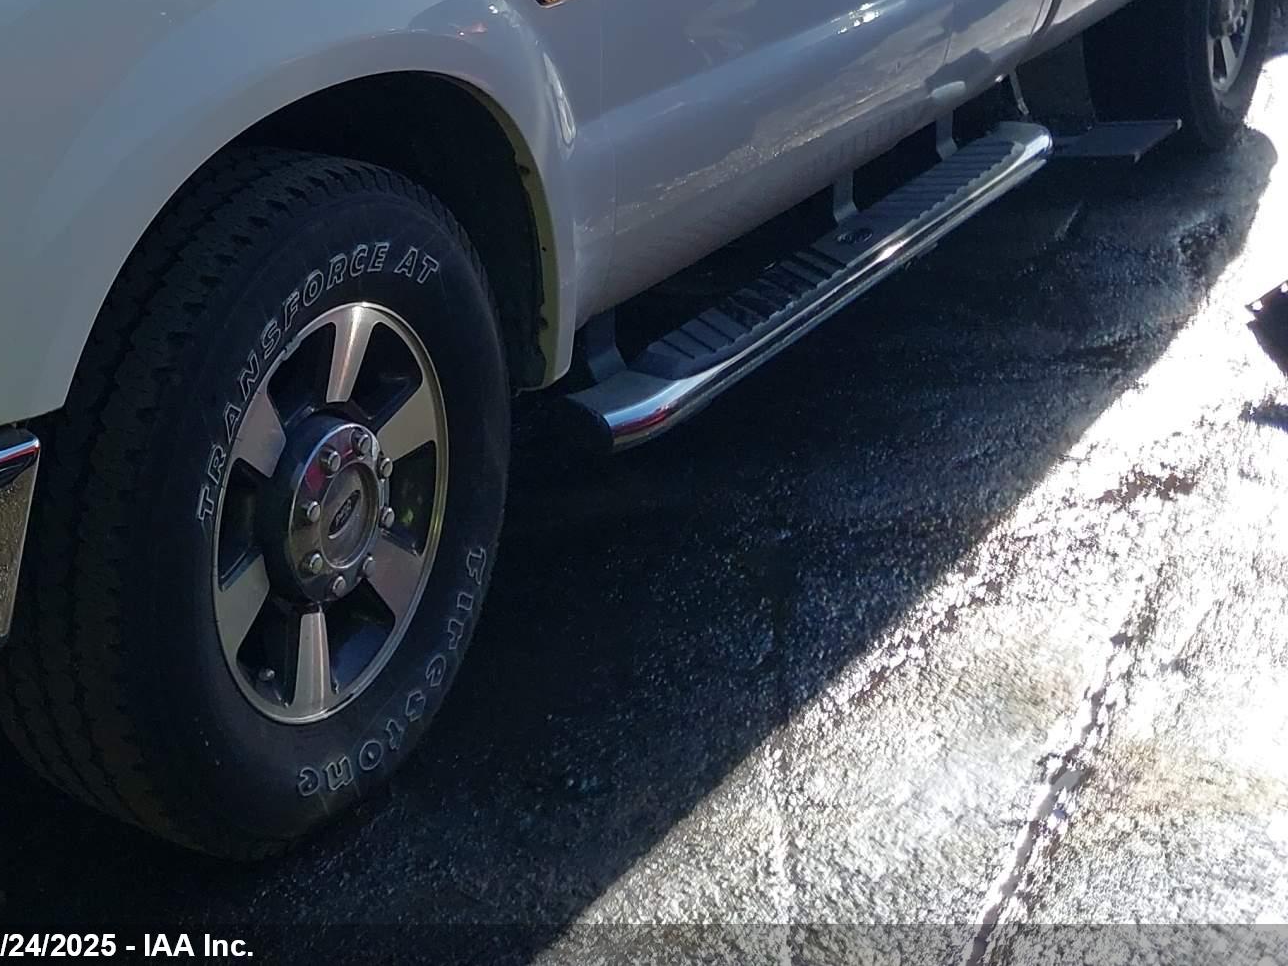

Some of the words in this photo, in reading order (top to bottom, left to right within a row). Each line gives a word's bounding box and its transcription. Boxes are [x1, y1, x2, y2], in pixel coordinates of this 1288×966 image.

[197, 241, 390, 522] TRANSFORCE
[394, 245, 440, 284] AT
[298, 547, 487, 797] Firestone
